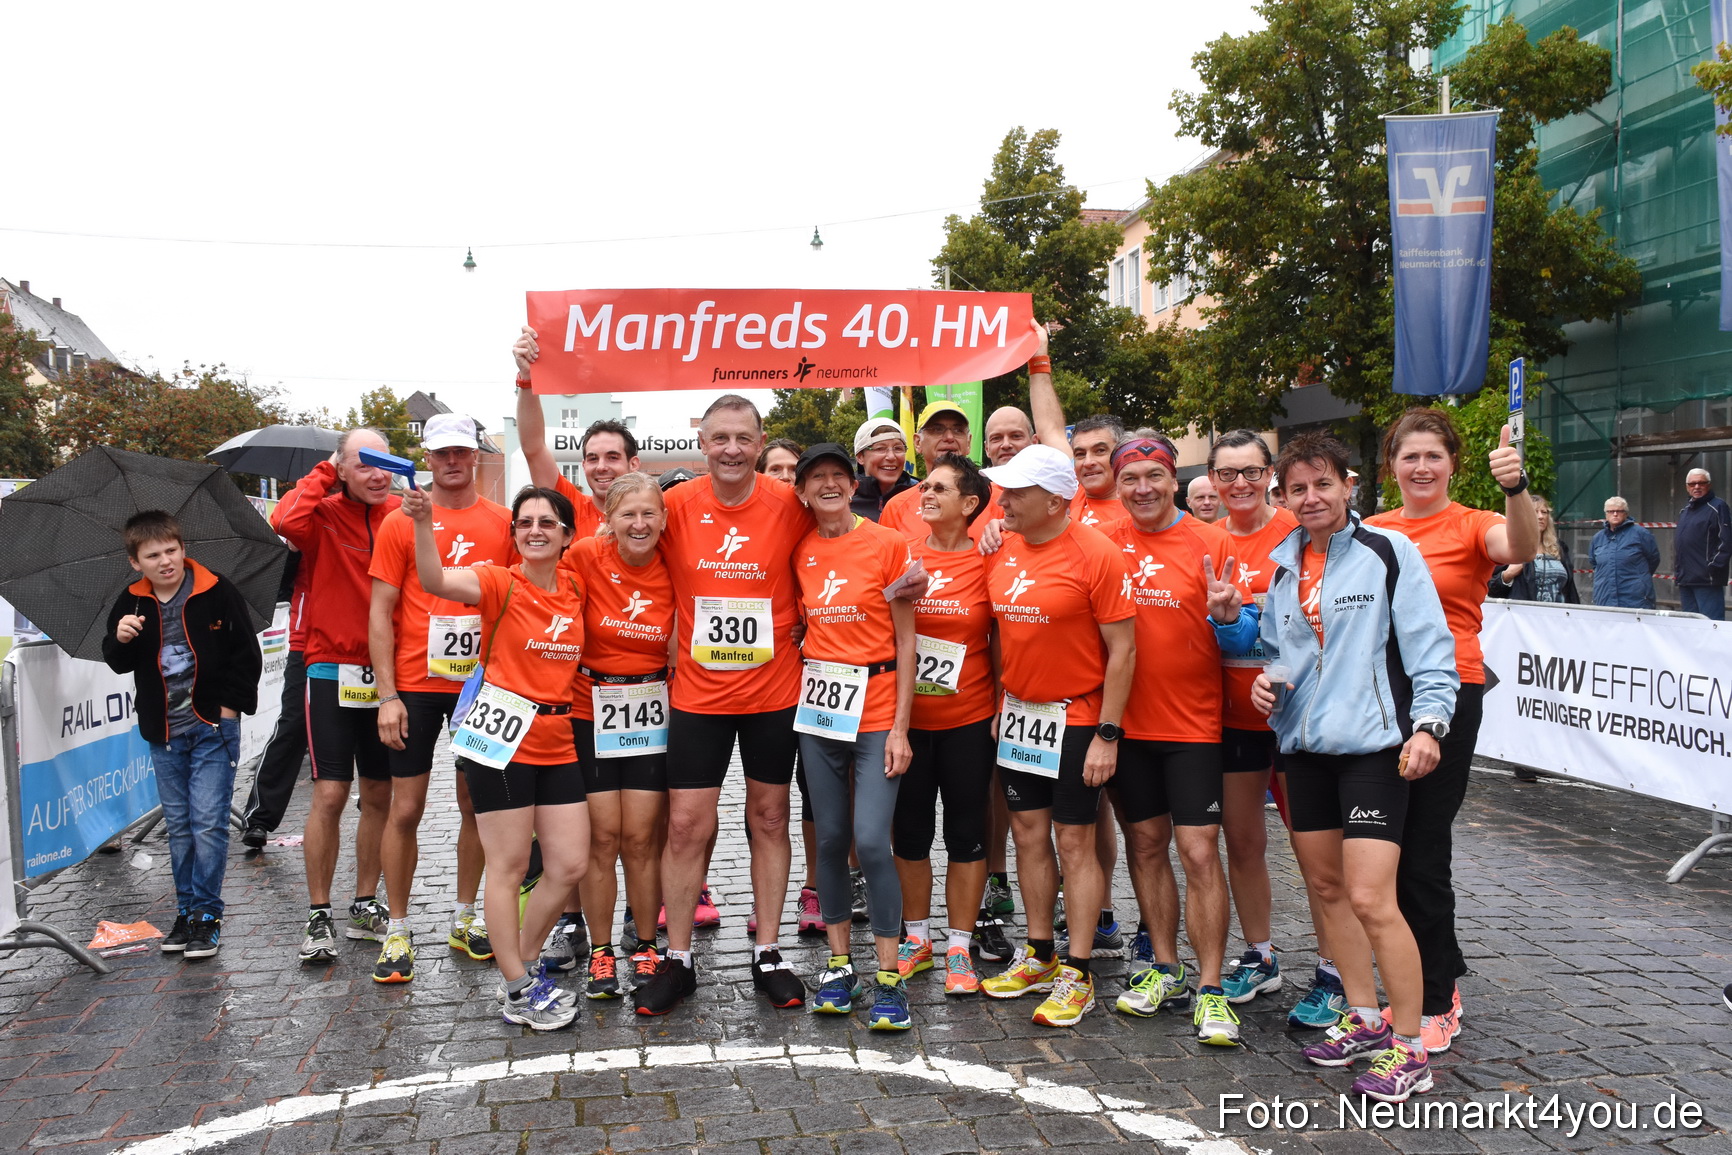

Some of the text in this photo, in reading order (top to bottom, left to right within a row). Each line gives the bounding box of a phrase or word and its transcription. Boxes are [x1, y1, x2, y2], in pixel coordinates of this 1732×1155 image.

[1400, 260, 1441, 269] Neumarkt
[564, 300, 1009, 362] Manfreds 40. HM
[712, 366, 878, 383] funrunners neumarkt
[1512, 367, 1520, 405] P
[696, 558, 759, 571] funrunners
[714, 570, 767, 580] neumarkt
[727, 600, 765, 611] BOCK
[1334, 593, 1375, 606] SIEMENS
[819, 612, 867, 624] neumarkt
[913, 606, 970, 616] neumarkt
[1004, 613, 1050, 624] neumarkt
[599, 615, 662, 634] funrunners
[708, 615, 758, 645] 330
[616, 629, 668, 642] neumarkt
[524, 638, 581, 653] funrunners
[710, 650, 754, 662] Manfred
[627, 684, 662, 697] BOCK
[915, 685, 937, 693] OLA
[1517, 651, 1732, 720] BMW EFFICIEN
[344, 689, 379, 700] Hans-W
[805, 677, 860, 712] 2287
[601, 699, 665, 730] 2143
[816, 713, 834, 728] Gabi
[1004, 711, 1058, 748] 2144
[1516, 695, 1732, 758] WENIGER VERBRAUCH.
[465, 734, 489, 753] Stilla
[618, 735, 650, 747] Conny
[1010, 747, 1043, 764] Roland
[27, 794, 72, 836] AUF
[129, 754, 156, 790] UHA
[1349, 805, 1388, 820] live
[26, 845, 73, 869] railone.de
